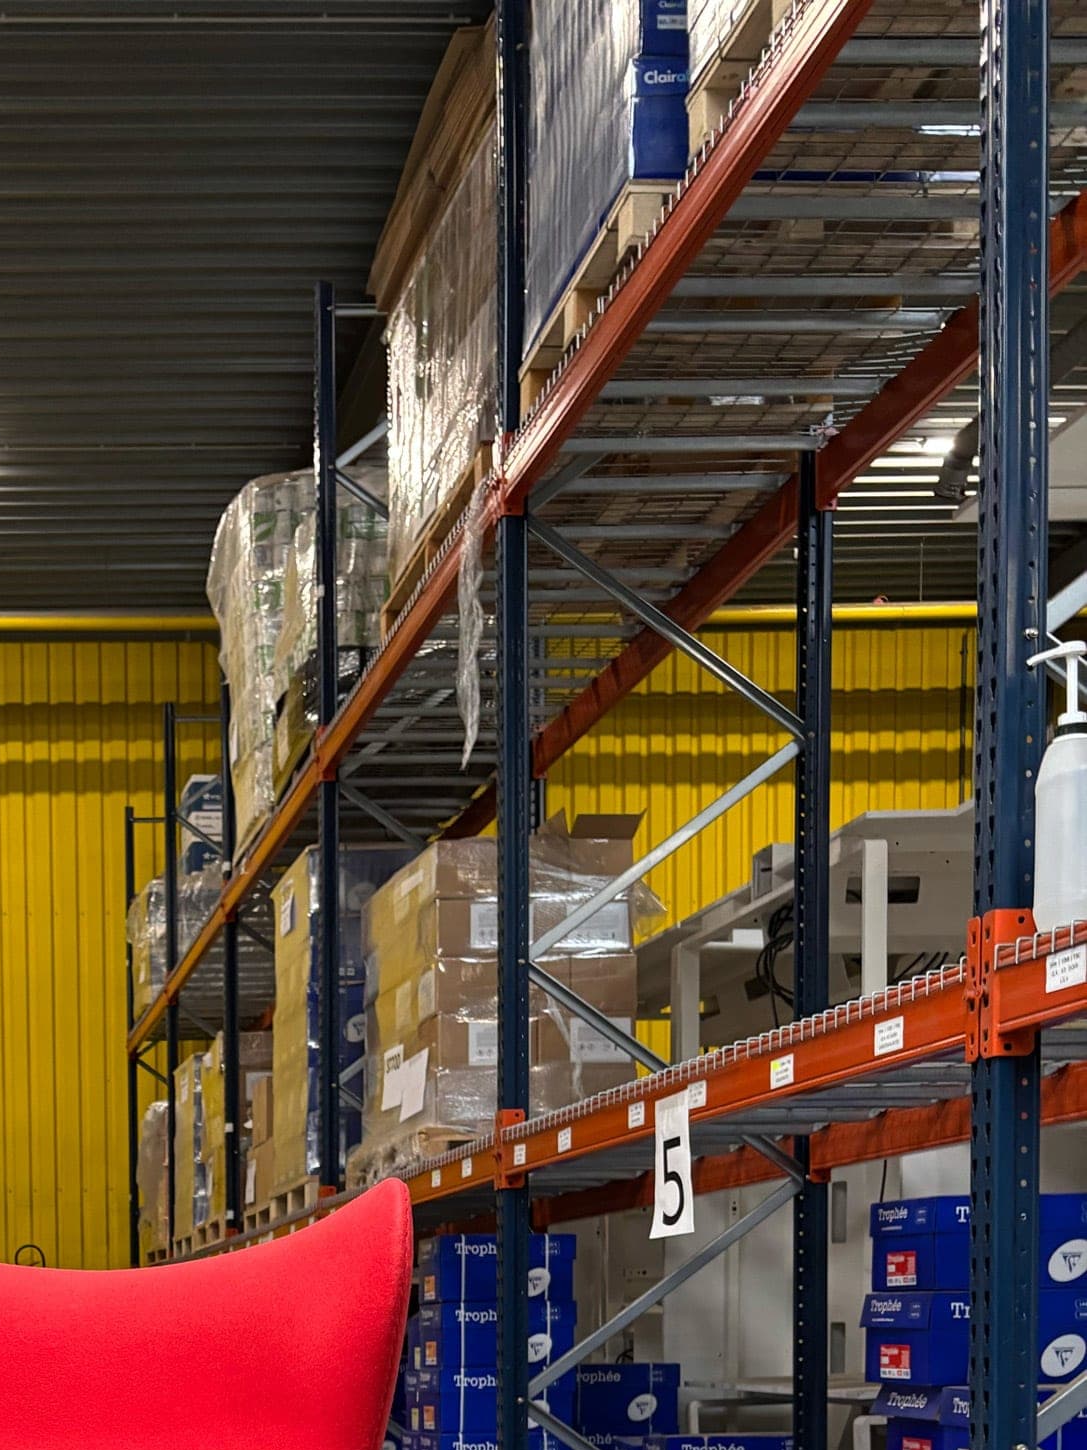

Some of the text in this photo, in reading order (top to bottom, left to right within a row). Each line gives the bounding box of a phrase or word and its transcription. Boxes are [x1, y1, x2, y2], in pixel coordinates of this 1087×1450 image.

[643, 69, 687, 84] Claira
[662, 1136, 684, 1226] 5
[878, 1207, 908, 1221] Trophée
[454, 1242, 498, 1257] Troph
[870, 1299, 902, 1316] Trophée
[455, 1309, 498, 1324] Troph
[453, 1374, 497, 1389] Troph
[577, 1371, 621, 1384] rophée
[887, 1392, 928, 1409] Trophée
